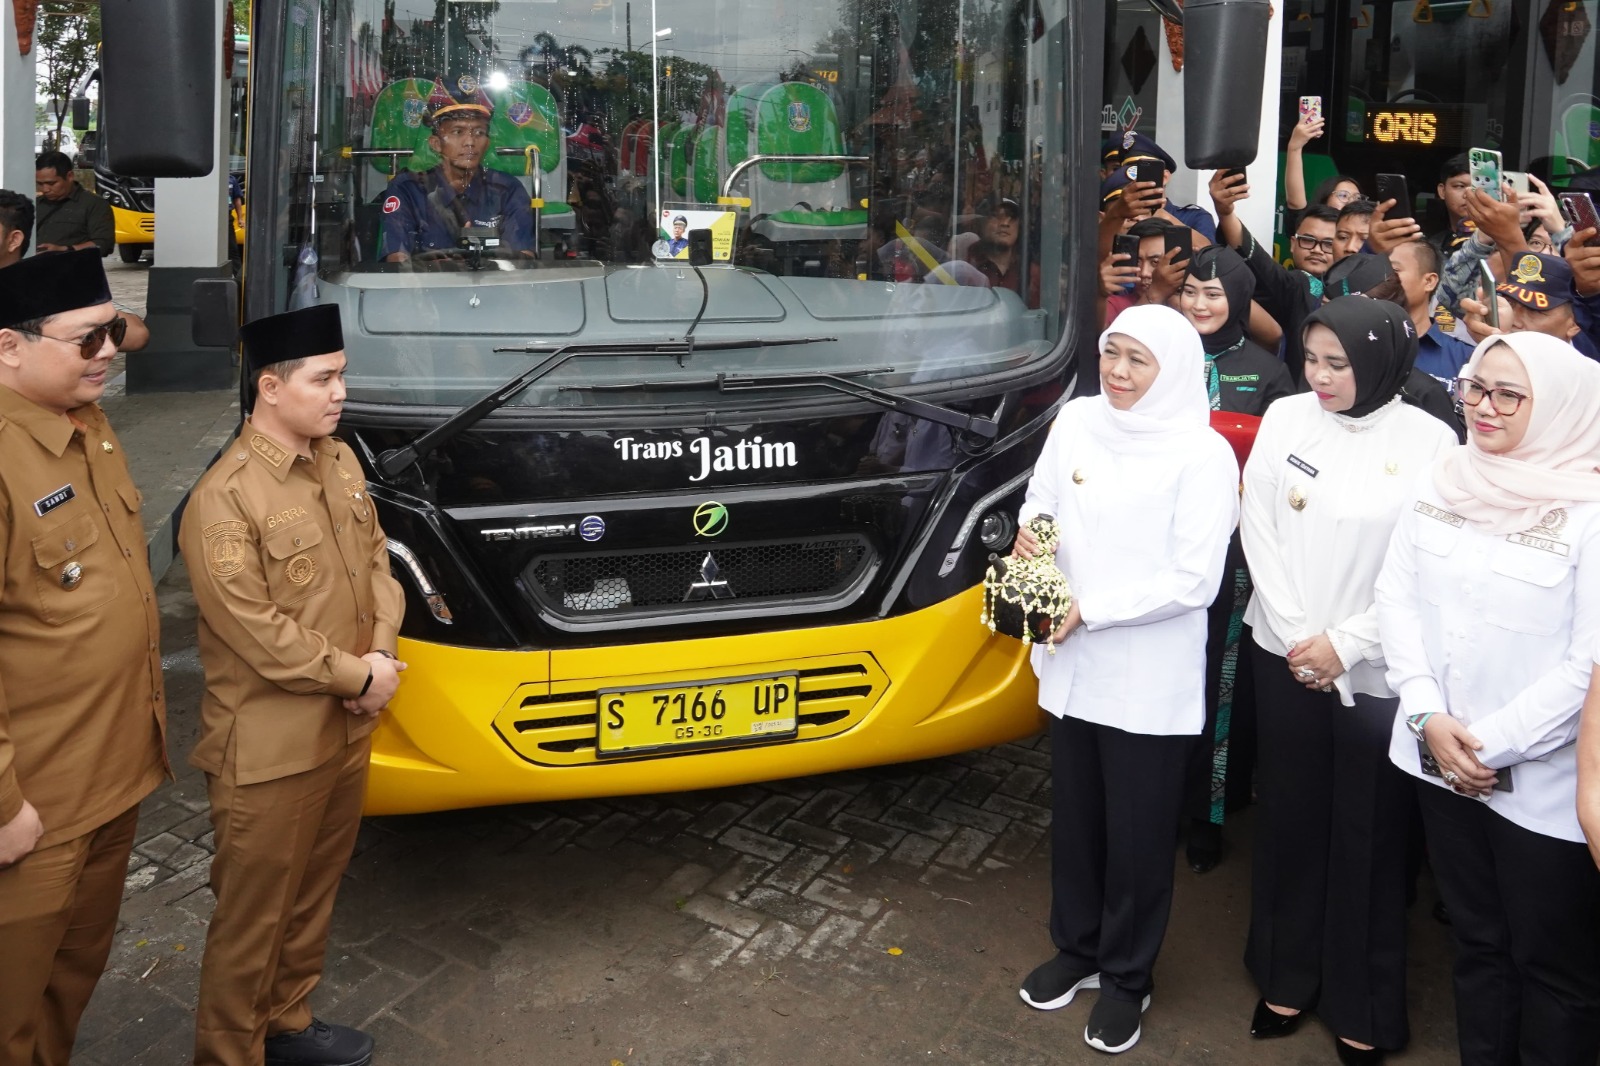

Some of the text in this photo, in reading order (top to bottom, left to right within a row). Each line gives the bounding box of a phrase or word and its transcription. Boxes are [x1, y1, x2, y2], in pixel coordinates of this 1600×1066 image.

[1101, 104, 1118, 126] ile
[1373, 112, 1437, 144] QRIS
[613, 435, 798, 482] Trans Jatim
[266, 506, 308, 529] BARRA
[480, 523, 576, 542] TENTREM
[1519, 535, 1555, 551] KETUA
[607, 682, 790, 730] S 7166 UP
